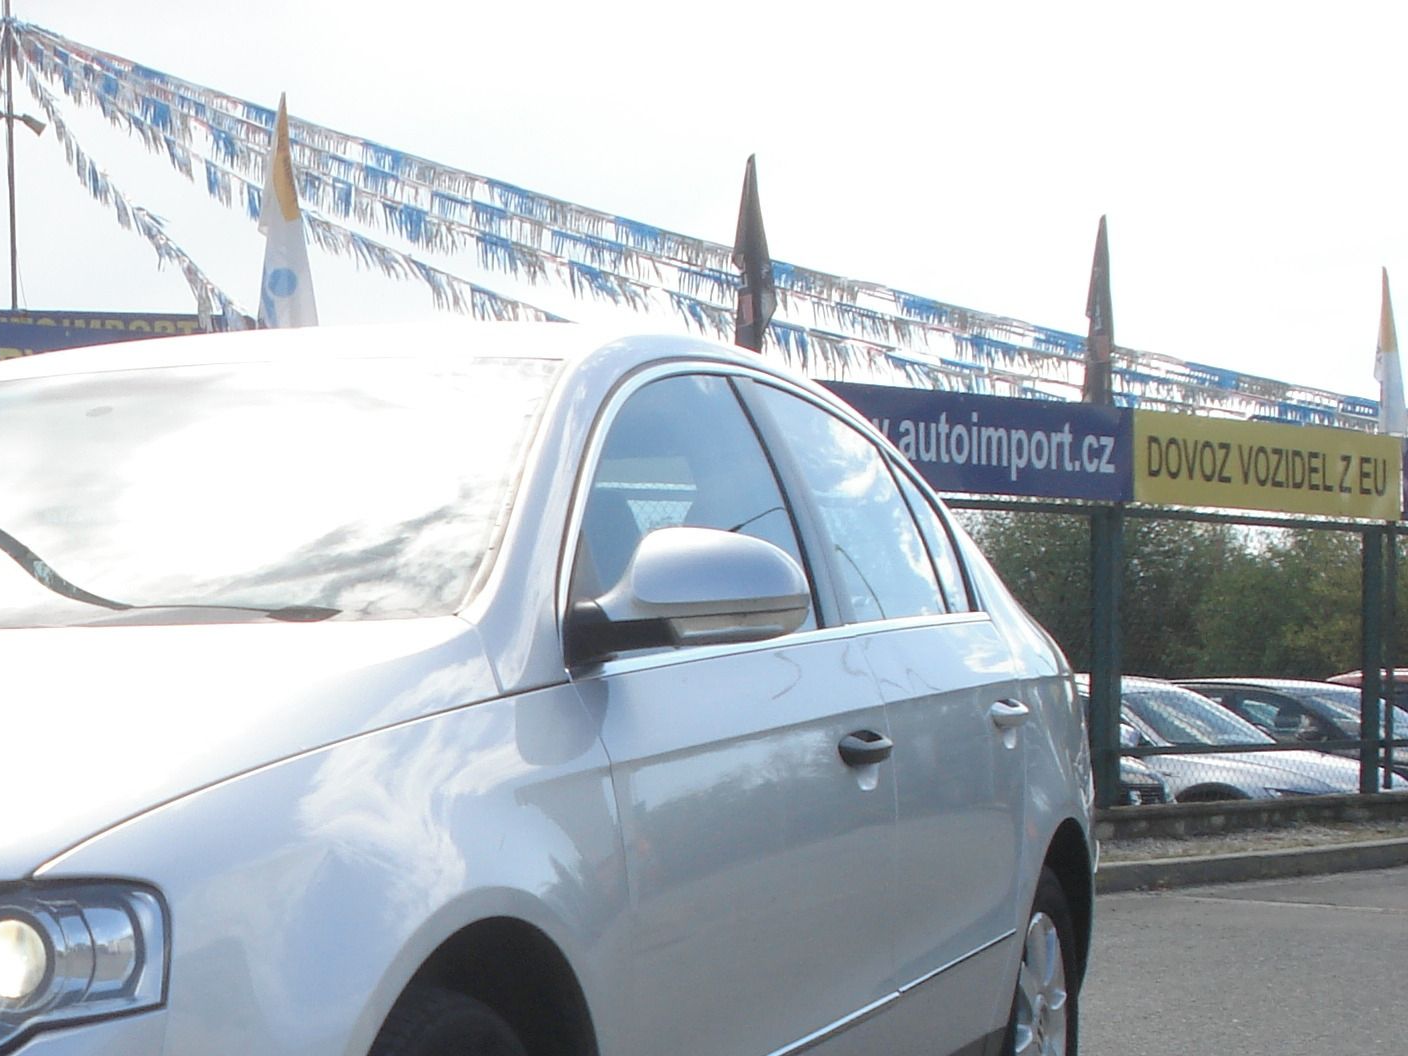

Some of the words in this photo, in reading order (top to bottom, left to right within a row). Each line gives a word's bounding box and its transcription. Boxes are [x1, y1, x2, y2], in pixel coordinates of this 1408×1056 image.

[873, 411, 1115, 481] autoimport.cz
[1147, 435, 1232, 484] DOVOZ
[1238, 444, 1334, 493] VOZIDEL
[1339, 454, 1353, 494] Z
[1359, 456, 1387, 497] EU
